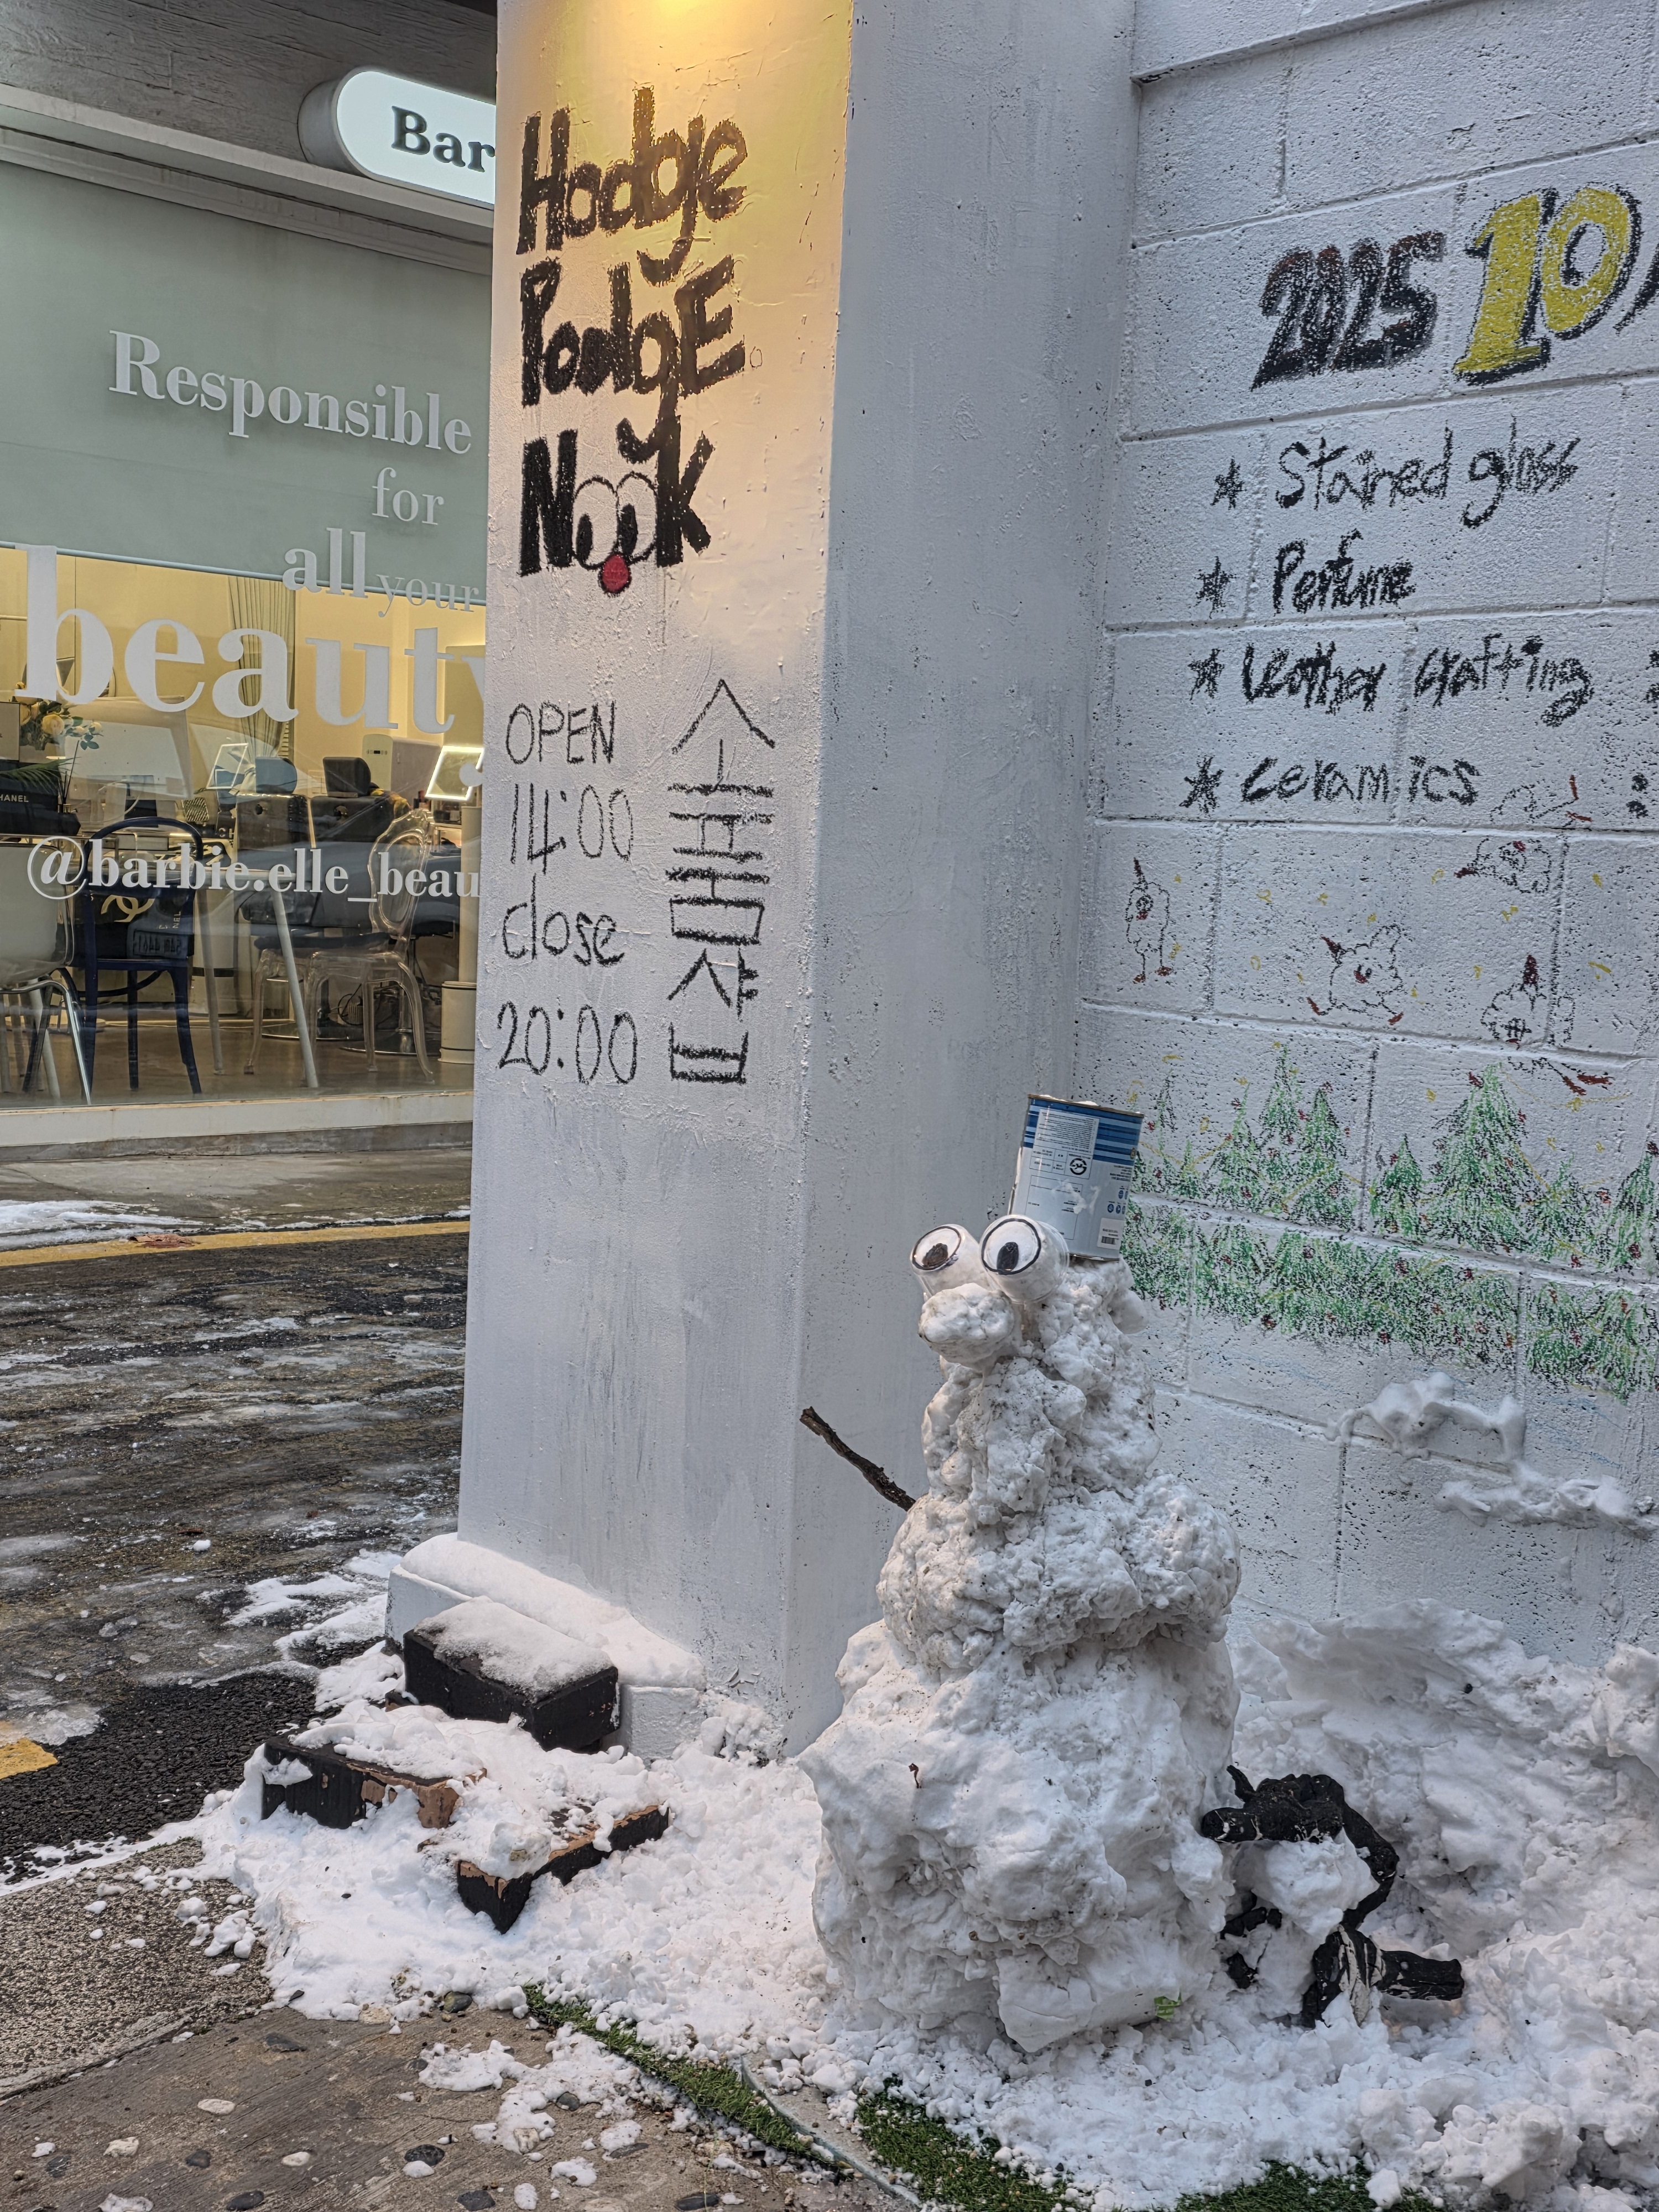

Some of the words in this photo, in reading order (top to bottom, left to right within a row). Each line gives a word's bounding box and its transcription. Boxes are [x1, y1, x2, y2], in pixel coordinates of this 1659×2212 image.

[391, 106, 495, 173] Bar
[109, 330, 471, 454] Responsible
[372, 467, 444, 525] for
[282, 527, 368, 598] all
[375, 574, 479, 618] your
[506, 700, 616, 764] OPEN
[511, 783, 634, 874] 14:00
[27, 836, 480, 902] @barbie.elle_beau
[498, 1000, 638, 1085] 20:00
